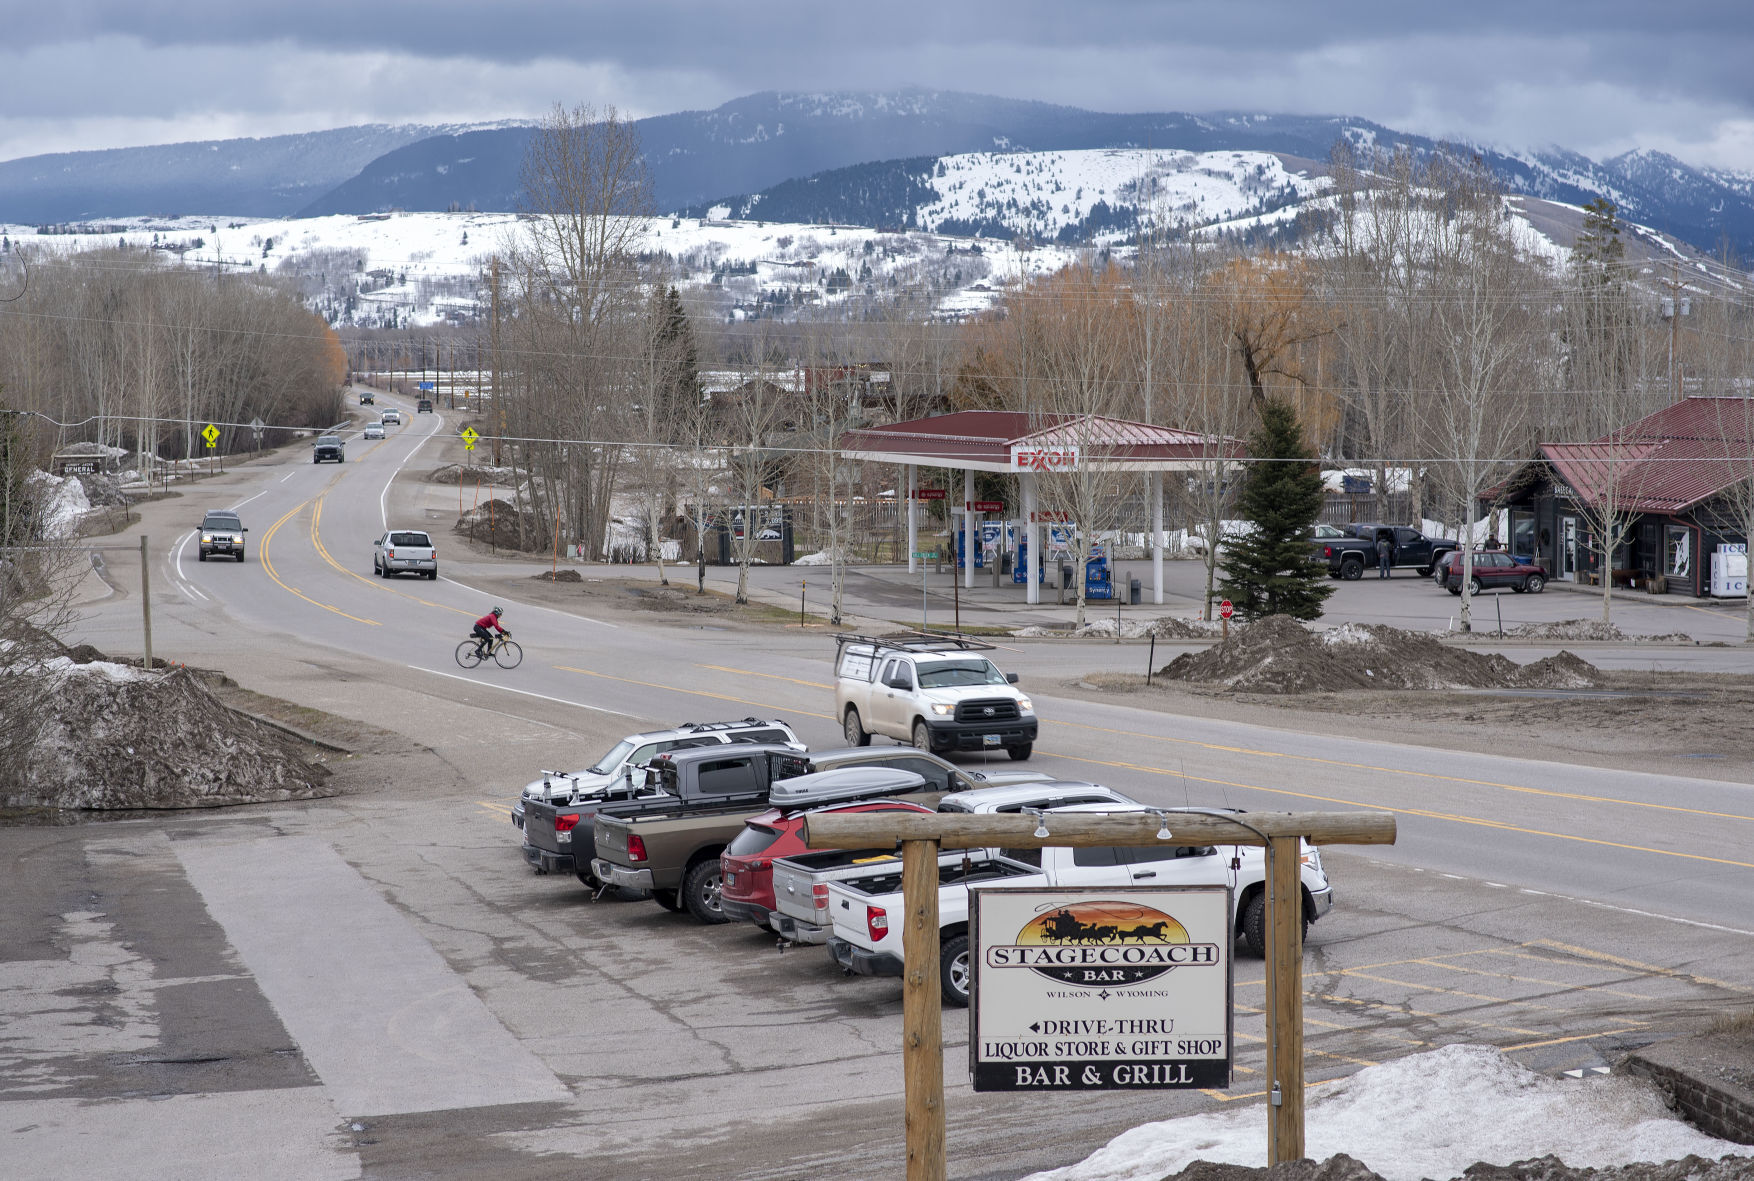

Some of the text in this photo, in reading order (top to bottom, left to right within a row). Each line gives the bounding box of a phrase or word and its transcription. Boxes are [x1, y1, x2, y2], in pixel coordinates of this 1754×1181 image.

[1017, 449, 1075, 472] EXXON
[1723, 544, 1745, 553] ICE
[1220, 605, 1233, 613] STOP
[994, 946, 1214, 965] STAGECOACH
[1083, 969, 1126, 981] BAR
[1115, 989, 1169, 998] WYOMING
[1043, 1018, 1175, 1035] DRIVE-THRU
[984, 1039, 1222, 1060] LIQUOR STORE & GIFT SHOP
[1015, 1064, 1194, 1086] BAR & GRILL
